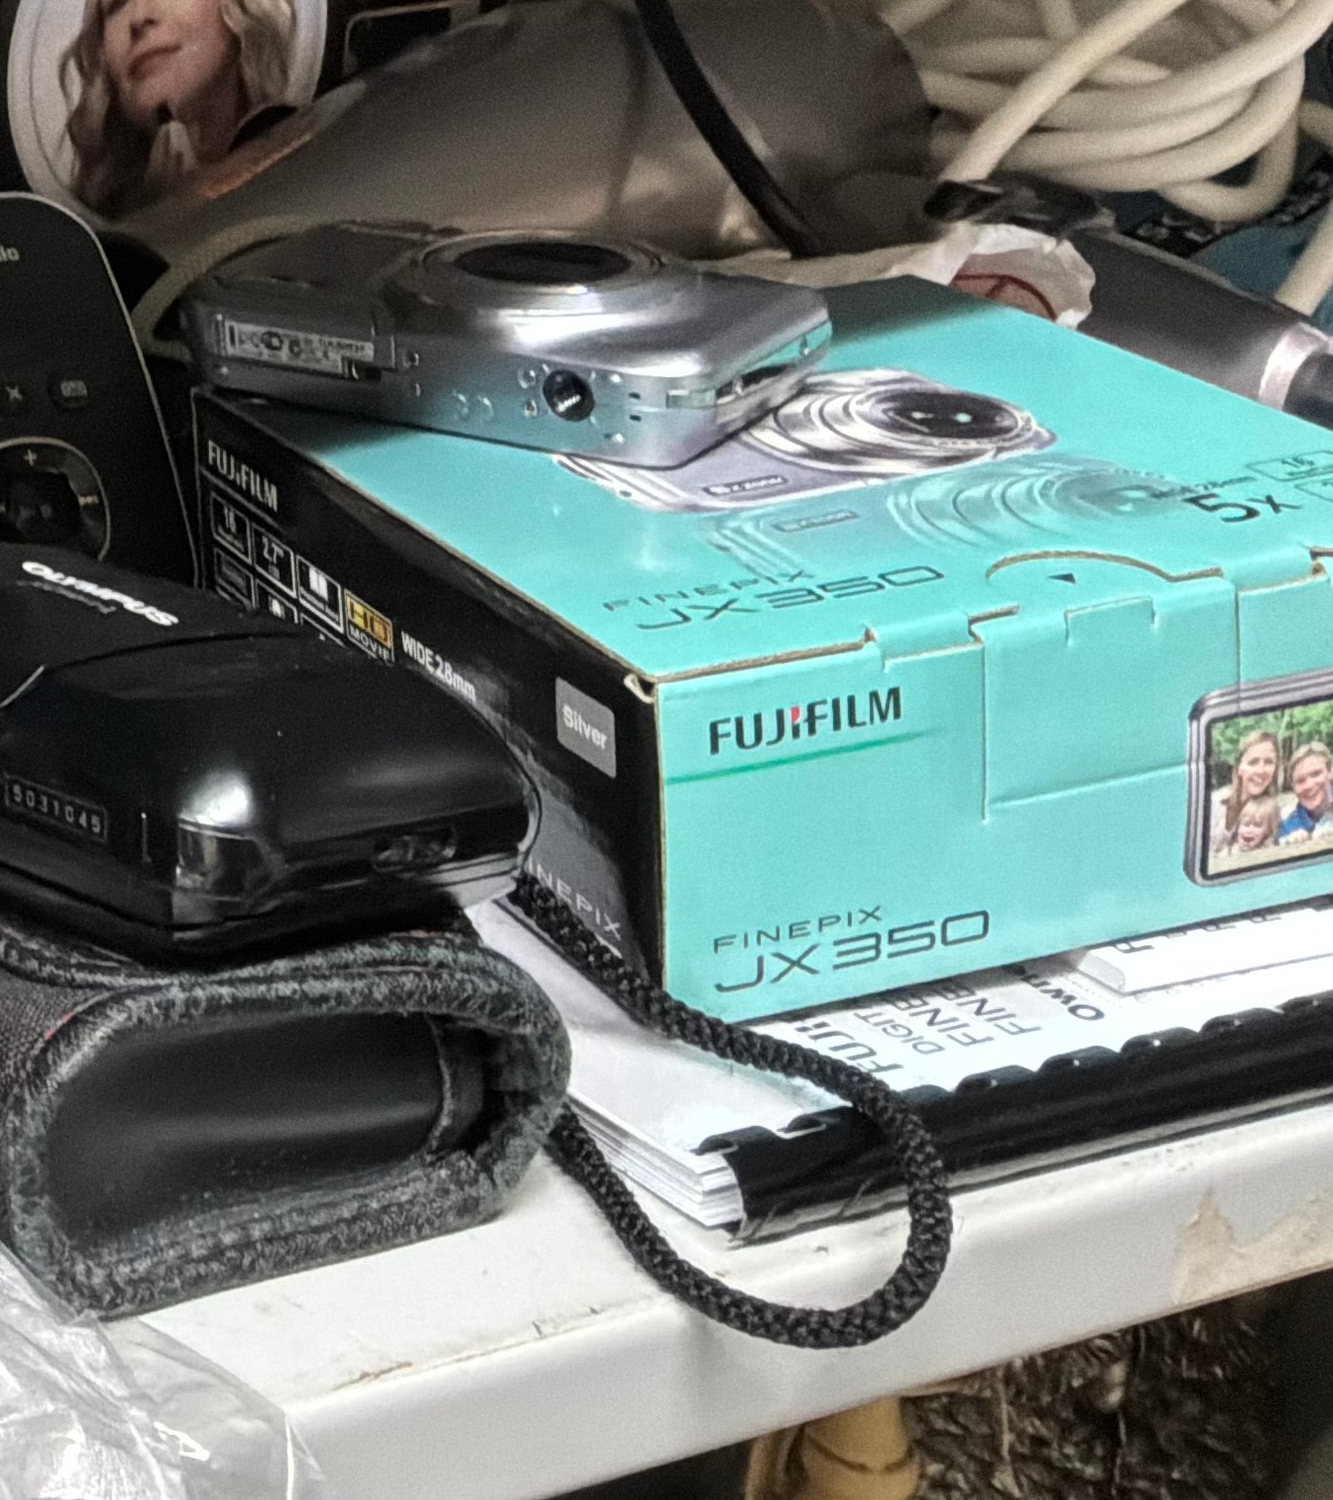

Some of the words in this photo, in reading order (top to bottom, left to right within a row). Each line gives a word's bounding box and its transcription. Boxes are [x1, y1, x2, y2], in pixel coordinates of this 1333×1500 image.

[207, 440, 279, 513] FUJIFILM
[349, 599, 389, 643] HD
[603, 570, 815, 612] FINEPIX
[637, 565, 946, 630] JX350
[401, 630, 434, 673] WIDE
[435, 656, 477, 702] 28mm
[562, 703, 609, 750] Silver
[709, 686, 902, 756] FUJIFILM
[713, 904, 883, 955] FINEPIX
[714, 909, 991, 995] JX350
